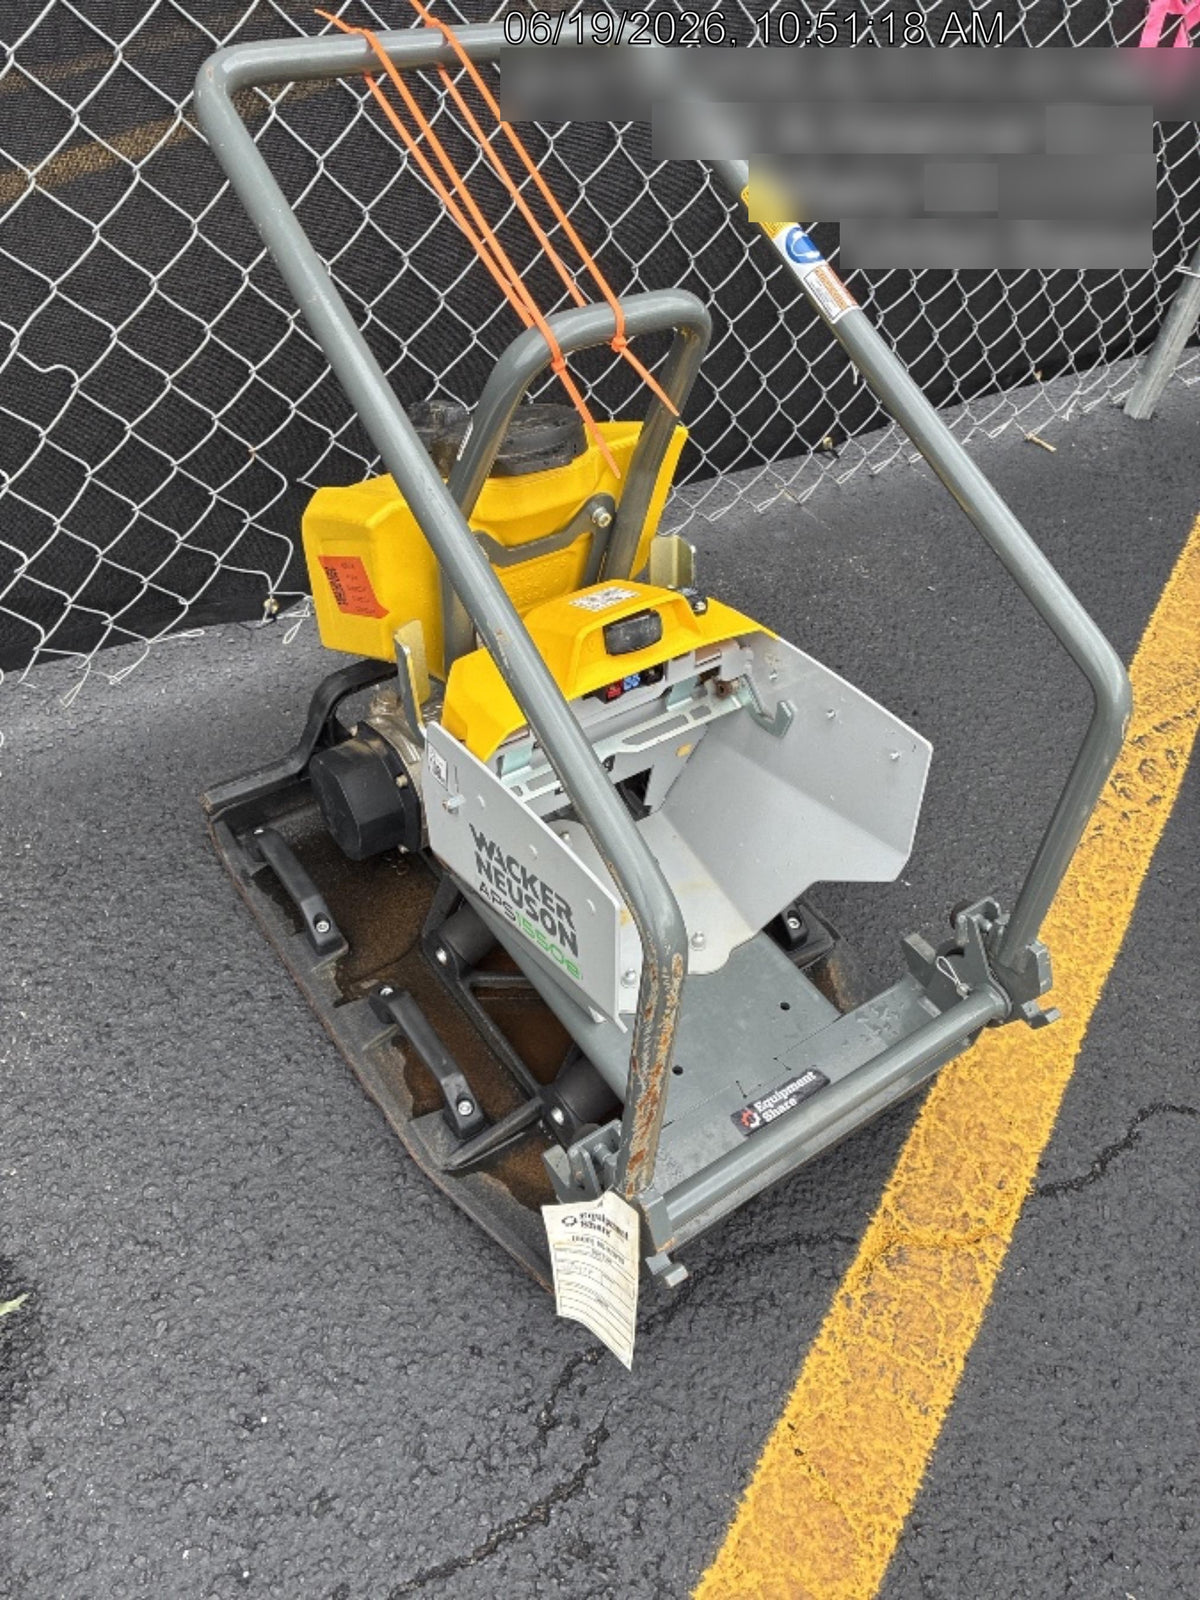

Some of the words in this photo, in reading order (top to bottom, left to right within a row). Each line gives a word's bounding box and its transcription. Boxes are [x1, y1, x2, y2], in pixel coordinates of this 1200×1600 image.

[469, 822, 576, 932] WACKER
[474, 850, 578, 957] NEUSON
[754, 1071, 817, 1112] Equipment
[762, 1097, 798, 1122] Share
